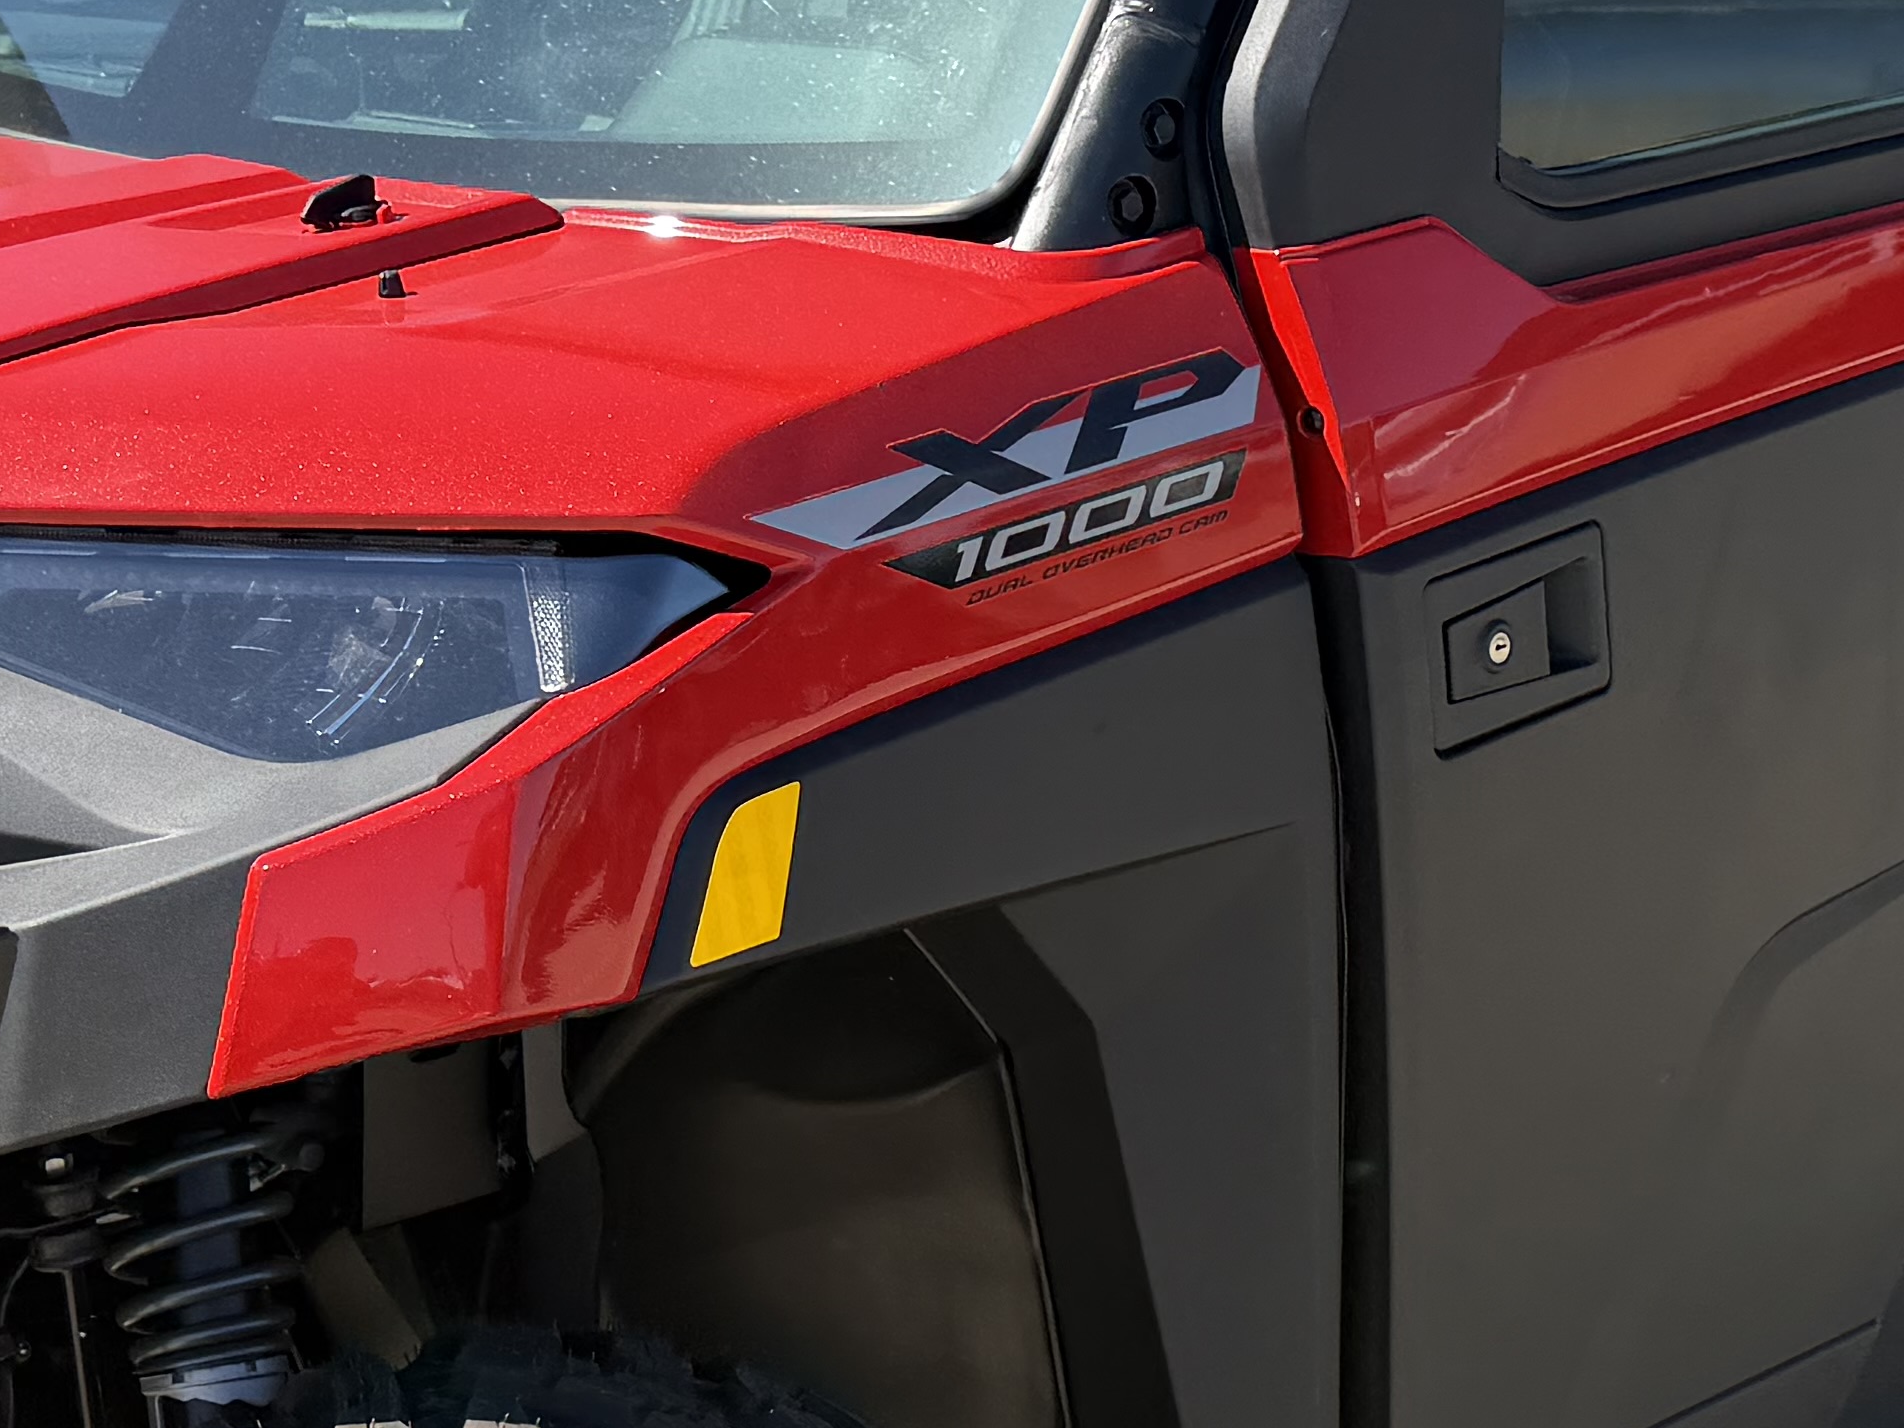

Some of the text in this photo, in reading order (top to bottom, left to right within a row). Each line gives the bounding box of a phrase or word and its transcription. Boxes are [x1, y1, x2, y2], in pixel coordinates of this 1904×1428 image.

[854, 347, 1247, 541] XP
[955, 460, 1224, 582] 1000
[965, 510, 1229, 607] DUAL OVERHEAD CAM
